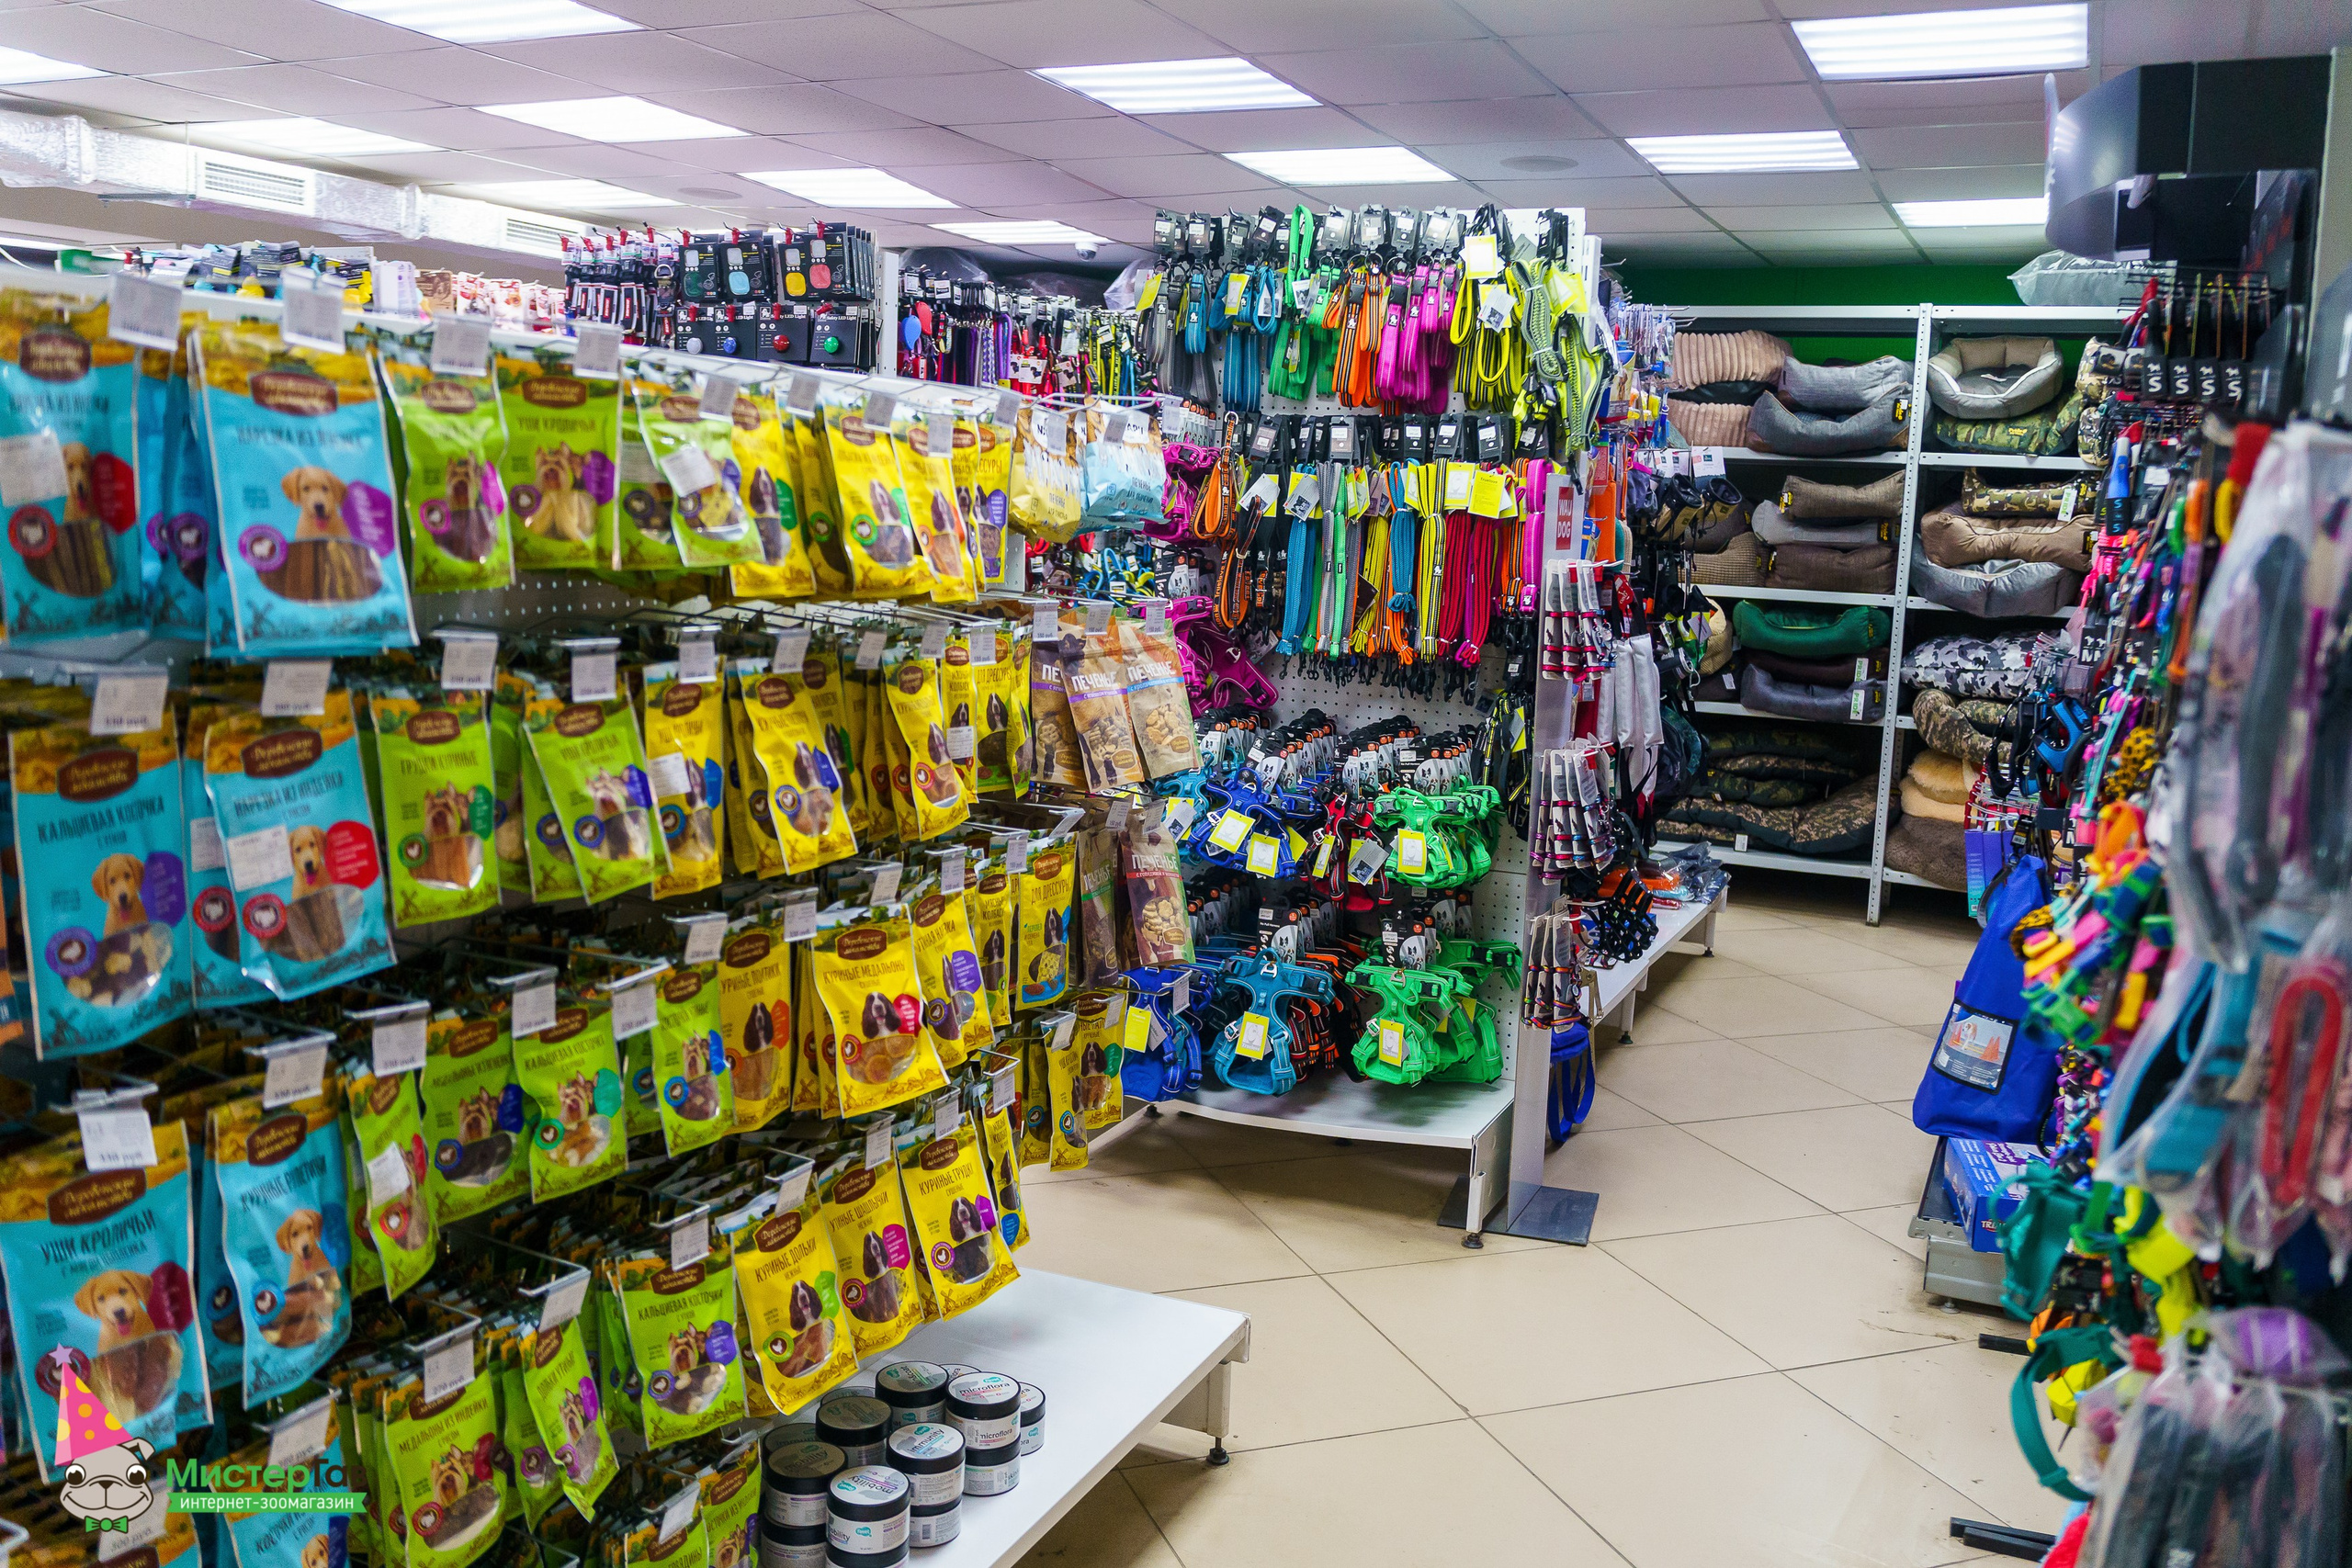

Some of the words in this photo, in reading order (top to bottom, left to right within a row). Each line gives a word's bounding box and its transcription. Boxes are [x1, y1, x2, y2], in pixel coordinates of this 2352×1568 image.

[2148, 376, 2163, 393] S
[2175, 378, 2189, 395] S
[2201, 378, 2216, 396] S
[2228, 379, 2242, 397] S
[1558, 499, 1573, 516] WAU
[1557, 521, 1571, 538] DOG
[1070, 671, 1119, 692] ПЕЧЕНЬЕ
[1127, 660, 1177, 682] ПЕЧЕНЬЕ
[1132, 853, 1179, 871] ПЕЧЕНЬЕ
[1031, 886, 1043, 905] ДЛЯ
[720, 972, 752, 995] УРИНЫЕ
[823, 965, 860, 986] КУРИНЫЕ
[859, 960, 906, 979] МЕДАЛЬОНЫ
[919, 1171, 955, 1197] КУРИНЫЕ
[829, 1210, 856, 1233] УТИНЫЕ
[40, 1235, 76, 1267] УШИ
[79, 1207, 156, 1256] КРОЛИЧЬИ
[754, 1252, 792, 1283] КУРИНЫЕ
[788, 1236, 817, 1267] ДОЛЬКИ
[637, 1298, 689, 1322] КАЛЬЦИЕВАЯ
[958, 1382, 1011, 1395] microflora
[398, 1422, 446, 1455] МЕДАЛЬОНЫ
[905, 1427, 945, 1453] immunity
[783, 1450, 829, 1471] mobility
[846, 1473, 895, 1495] mobility
